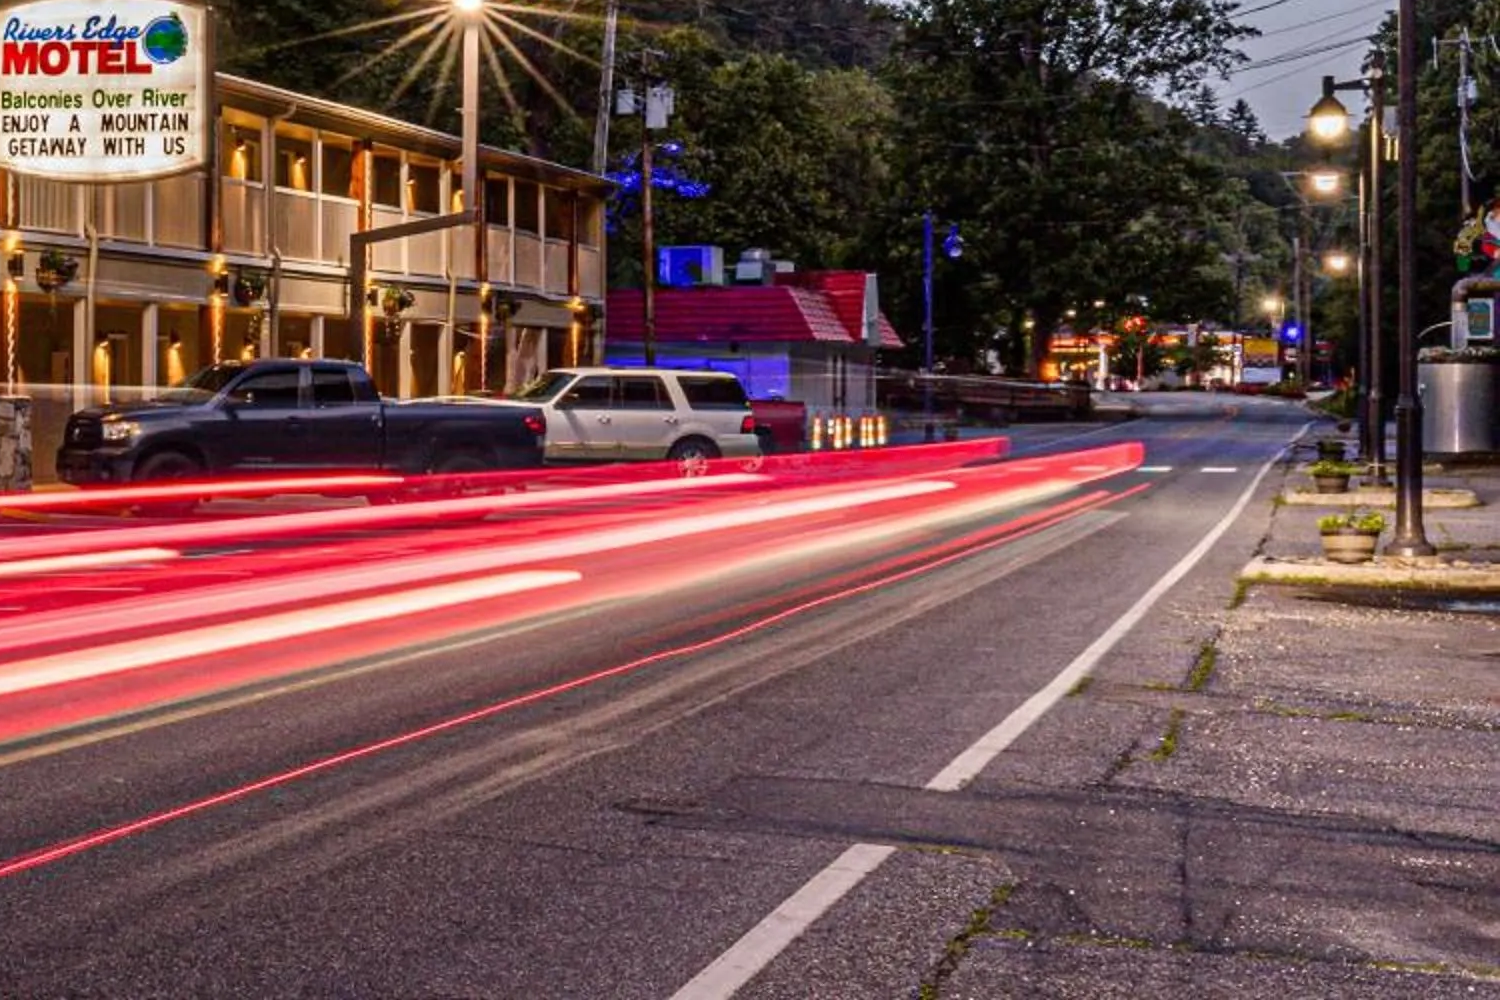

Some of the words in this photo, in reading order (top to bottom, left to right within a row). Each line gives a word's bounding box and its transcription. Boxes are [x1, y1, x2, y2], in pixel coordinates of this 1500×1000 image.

[82, 14, 143, 48] Edge
[2, 41, 152, 75] MOTEL
[1, 89, 83, 109] Balconies
[92, 89, 133, 108] Over
[142, 88, 188, 107] River
[2, 114, 49, 132] ENJOY
[69, 113, 80, 132] A
[101, 112, 188, 132] MOUNTAIN
[8, 137, 86, 156] GETAWAY
[103, 137, 145, 155] WITH
[163, 136, 185, 155] US
